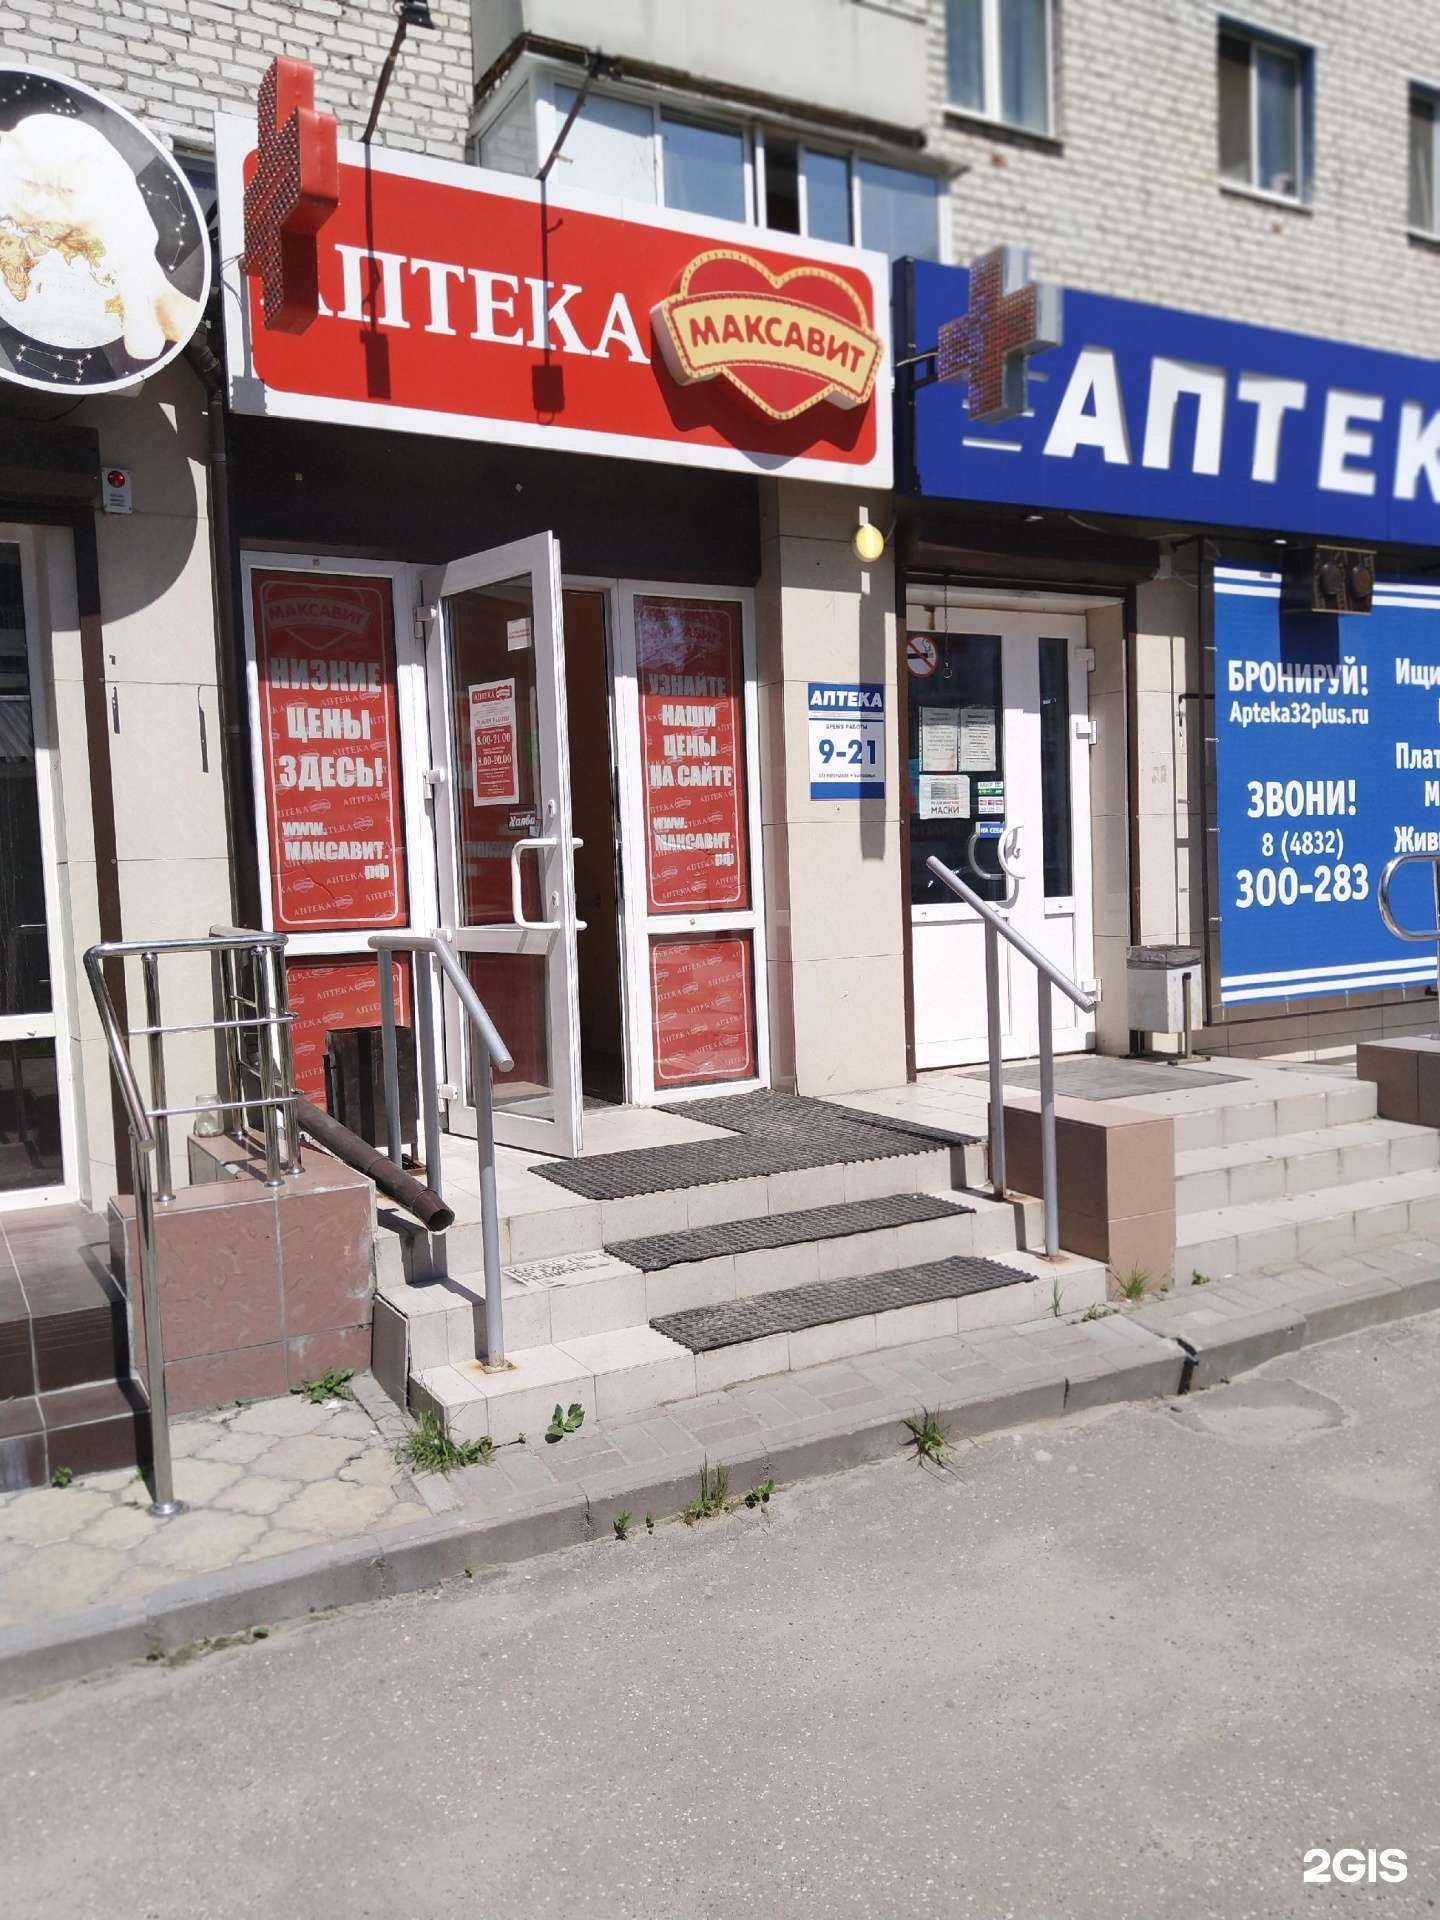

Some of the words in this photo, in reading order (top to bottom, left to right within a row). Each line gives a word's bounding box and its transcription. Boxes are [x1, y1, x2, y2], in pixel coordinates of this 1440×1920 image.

[316, 244, 652, 365] ПТЕКА
[688, 315, 868, 375] МАКСАВИТ
[269, 602, 366, 625] МАКСАВИТ
[270, 657, 382, 693] НИЗКИЕ
[648, 671, 727, 697] УЗНАЙТЕ
[1228, 655, 1369, 697] БРОНИРУЙ!
[810, 690, 883, 708] АПТЕКА
[1229, 700, 1370, 729] Apteka32plus.ru
[286, 706, 371, 744] ЦЕНЫ
[662, 704, 716, 727] НАШИ
[663, 734, 716, 758] ЦЕНЫ
[818, 738, 876, 765] 9-21
[278, 754, 384, 792] ЗДЕСЬ!
[649, 764, 675, 787] НА
[677, 761, 733, 787] САЙТЕ
[930, 806, 960, 815] МАСКИ
[1247, 779, 1357, 818] ЗВОНИ!
[1262, 832, 1274, 857] 8
[1281, 829, 1344, 864] (4832)
[1235, 863, 1370, 909] 300-283
